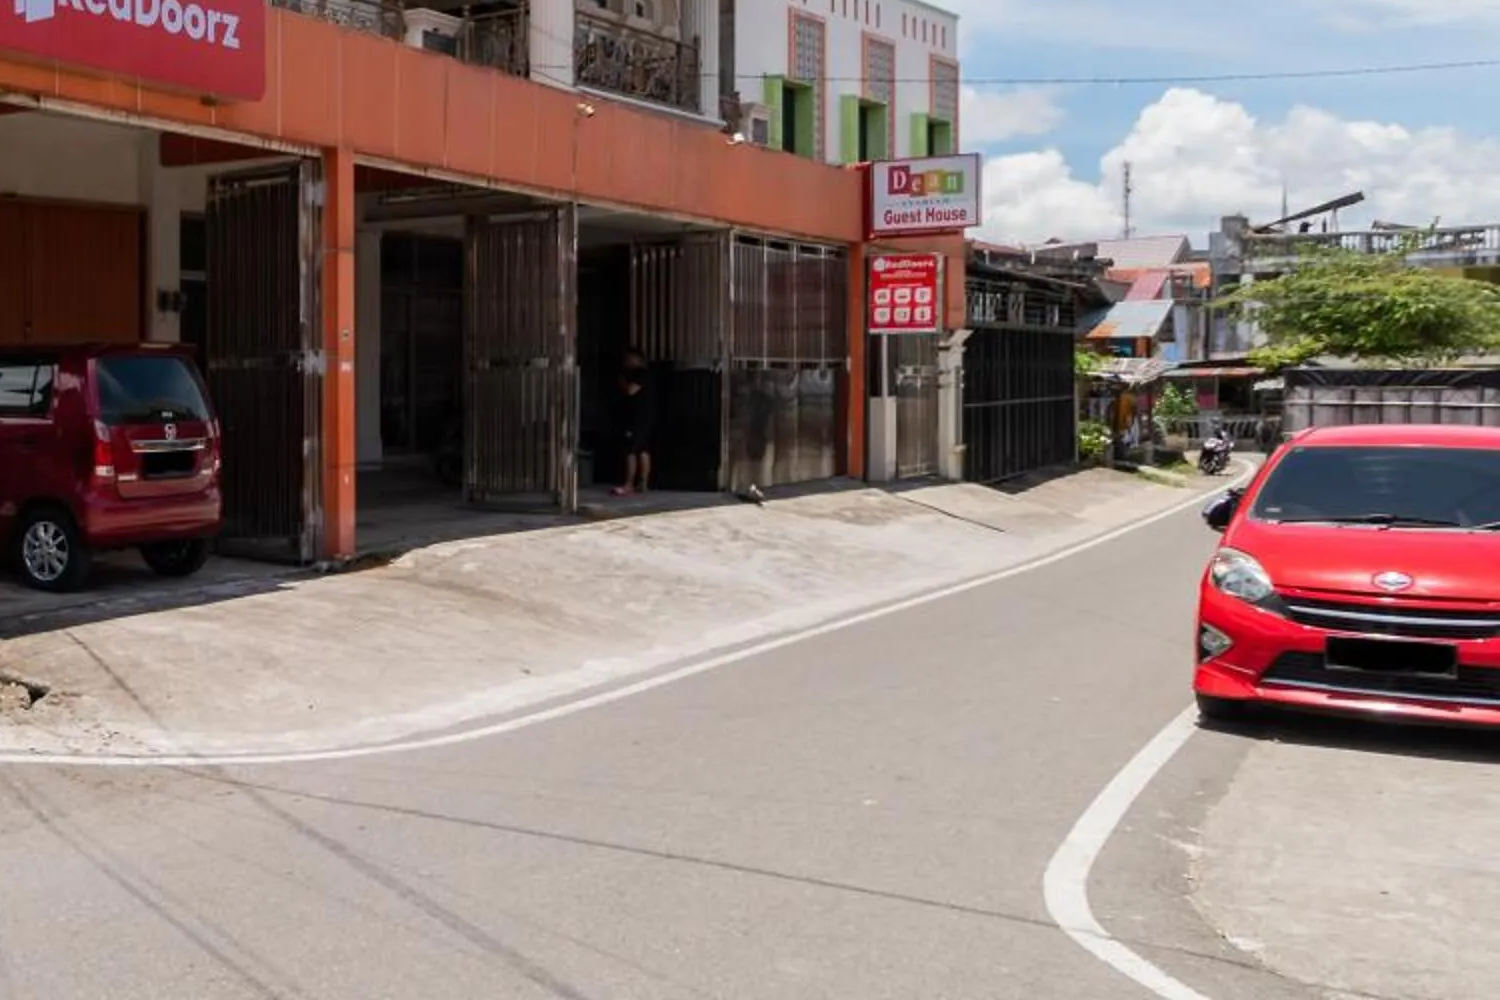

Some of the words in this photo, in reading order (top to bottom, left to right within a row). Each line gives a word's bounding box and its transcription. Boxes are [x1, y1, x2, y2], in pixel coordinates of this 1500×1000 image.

[892, 169, 958, 193] Dean
[884, 209, 922, 225] Guest
[925, 207, 967, 222] House
